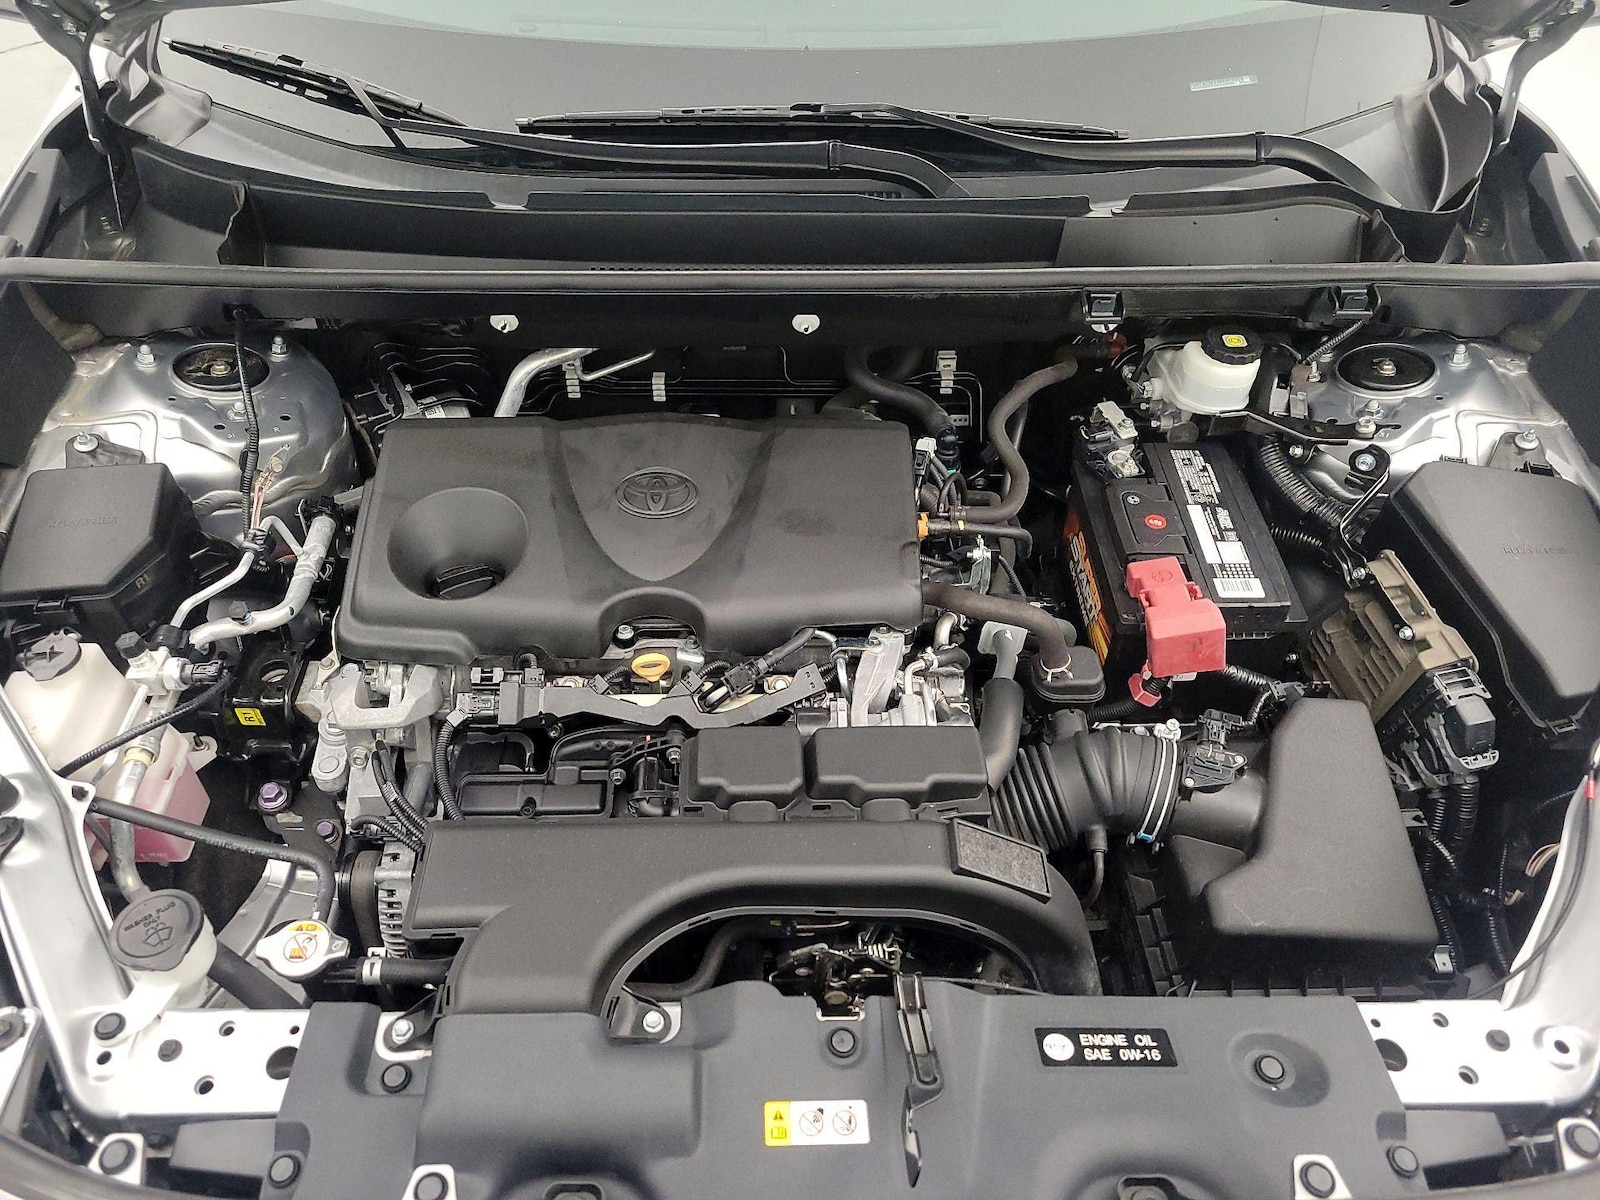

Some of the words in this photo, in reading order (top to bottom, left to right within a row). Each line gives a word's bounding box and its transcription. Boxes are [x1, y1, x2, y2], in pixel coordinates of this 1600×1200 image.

[123, 913, 153, 932] WASHER
[156, 901, 176, 915] FLUID
[143, 914, 161, 928] ONLY
[1079, 1033, 1129, 1046] ENGINE
[1134, 1033, 1158, 1047] OIL
[1083, 1047, 1113, 1061] SAE
[1119, 1048, 1162, 1061] 0W-16
